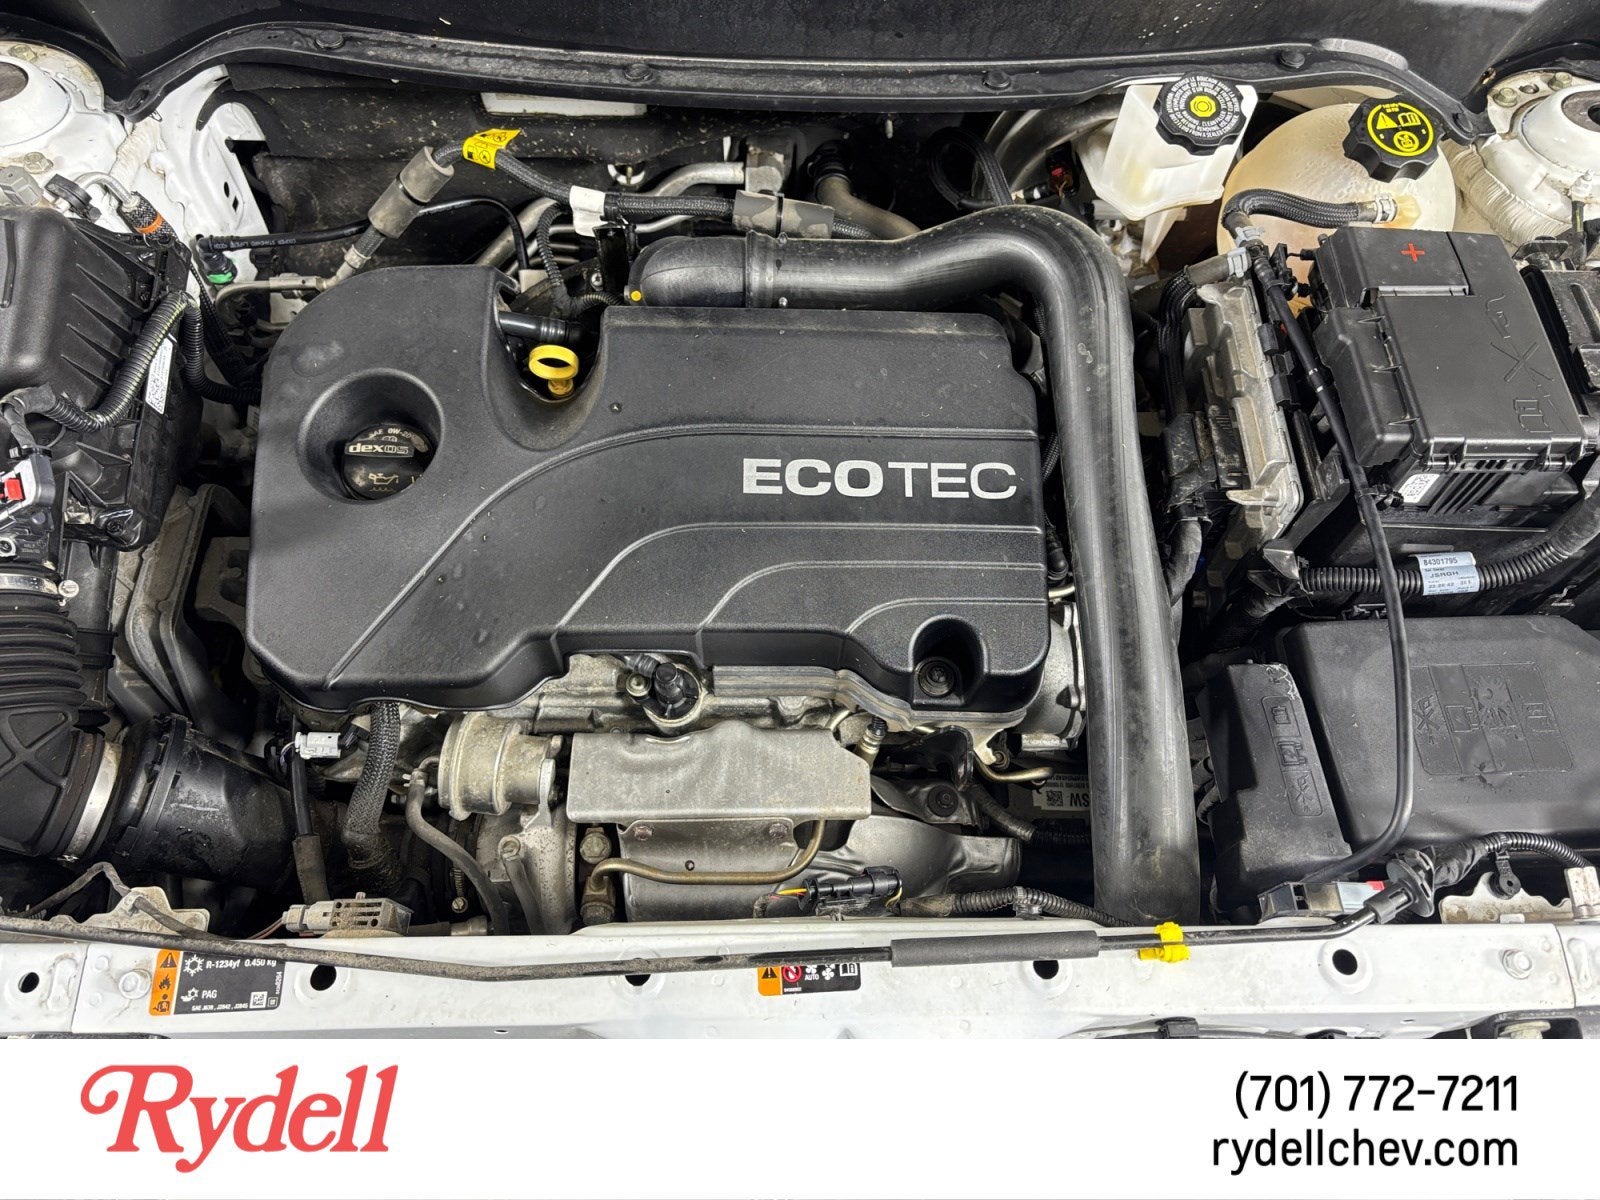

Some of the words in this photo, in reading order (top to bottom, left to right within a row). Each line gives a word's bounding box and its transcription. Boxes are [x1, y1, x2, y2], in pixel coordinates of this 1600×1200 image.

[742, 457, 1017, 500] ECOTEC
[804, 973, 820, 981] AUTO
[201, 990, 218, 999] PAG
